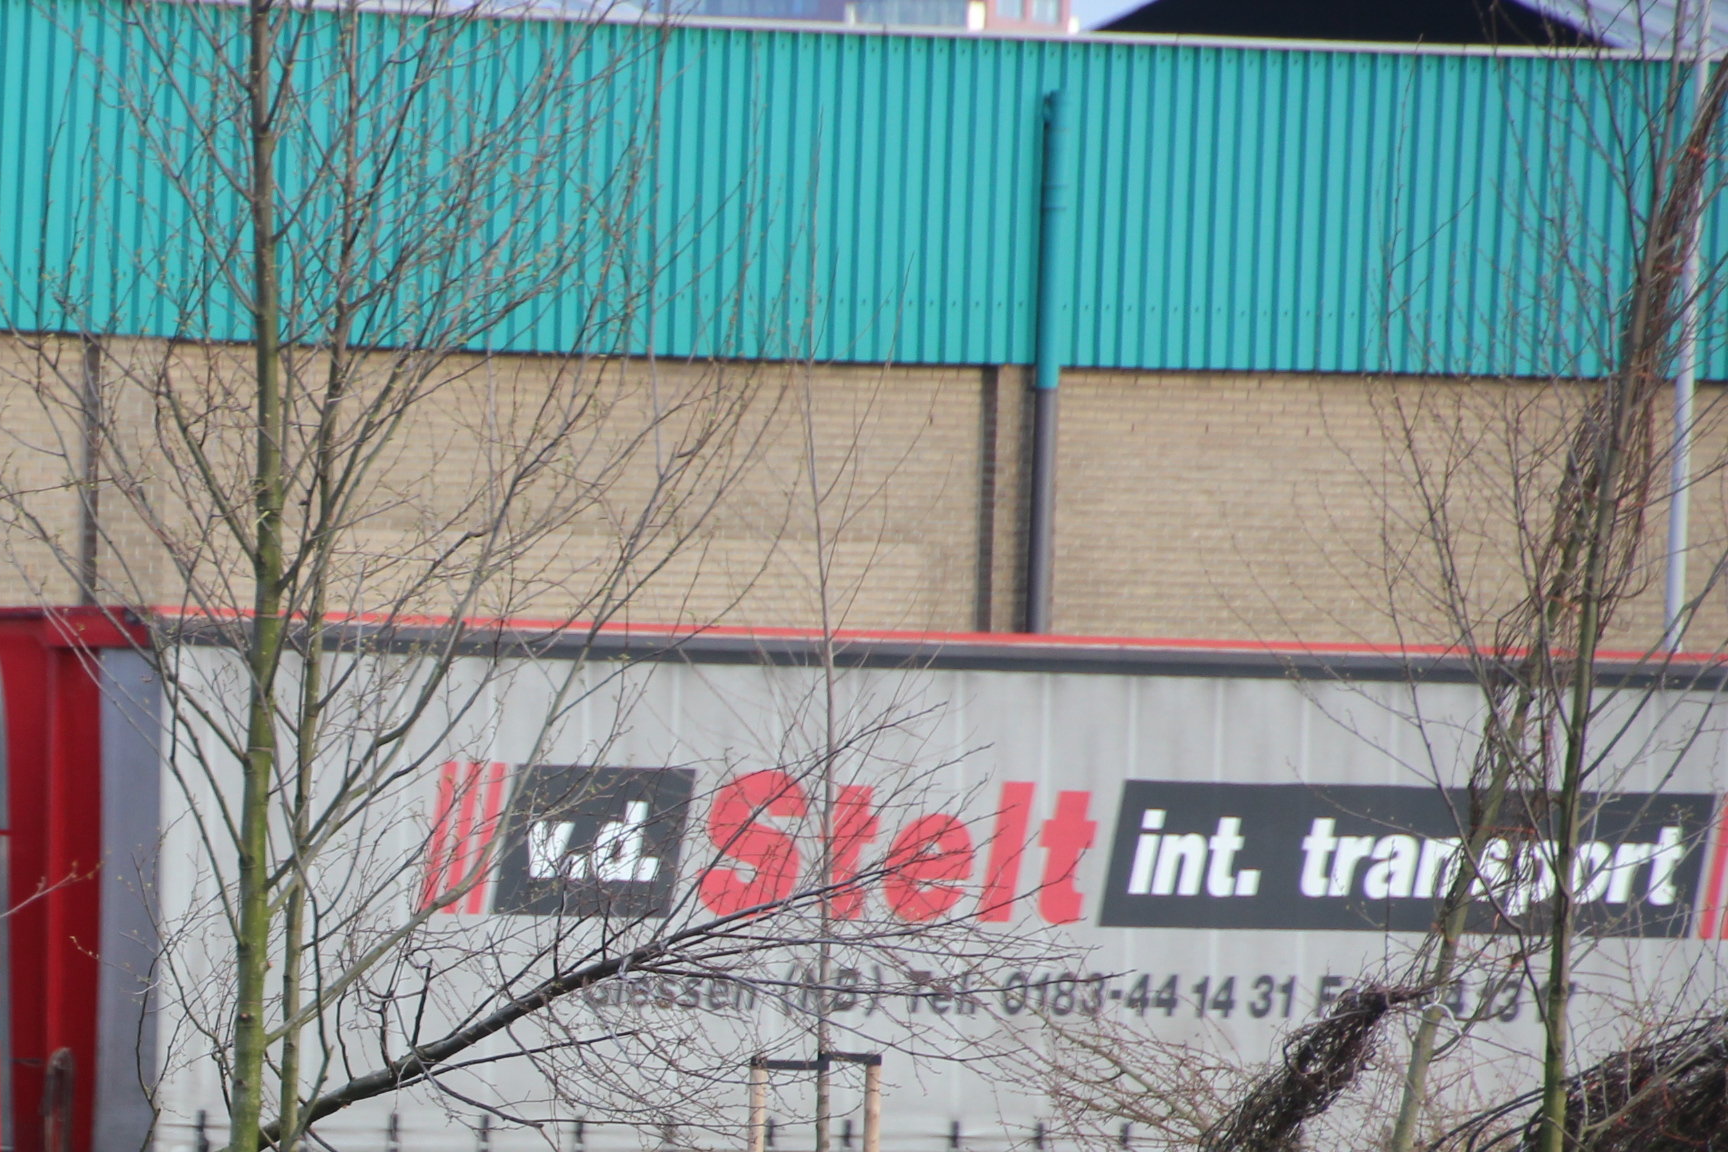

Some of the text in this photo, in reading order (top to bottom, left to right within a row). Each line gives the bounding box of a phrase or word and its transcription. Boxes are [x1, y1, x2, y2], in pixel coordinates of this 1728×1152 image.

[528, 800, 660, 882] v.d.
[696, 769, 1098, 926] Stelt
[1128, 808, 1261, 897] int.
[1191, 976, 1236, 1019] 14
[1249, 974, 1296, 1019] 31
